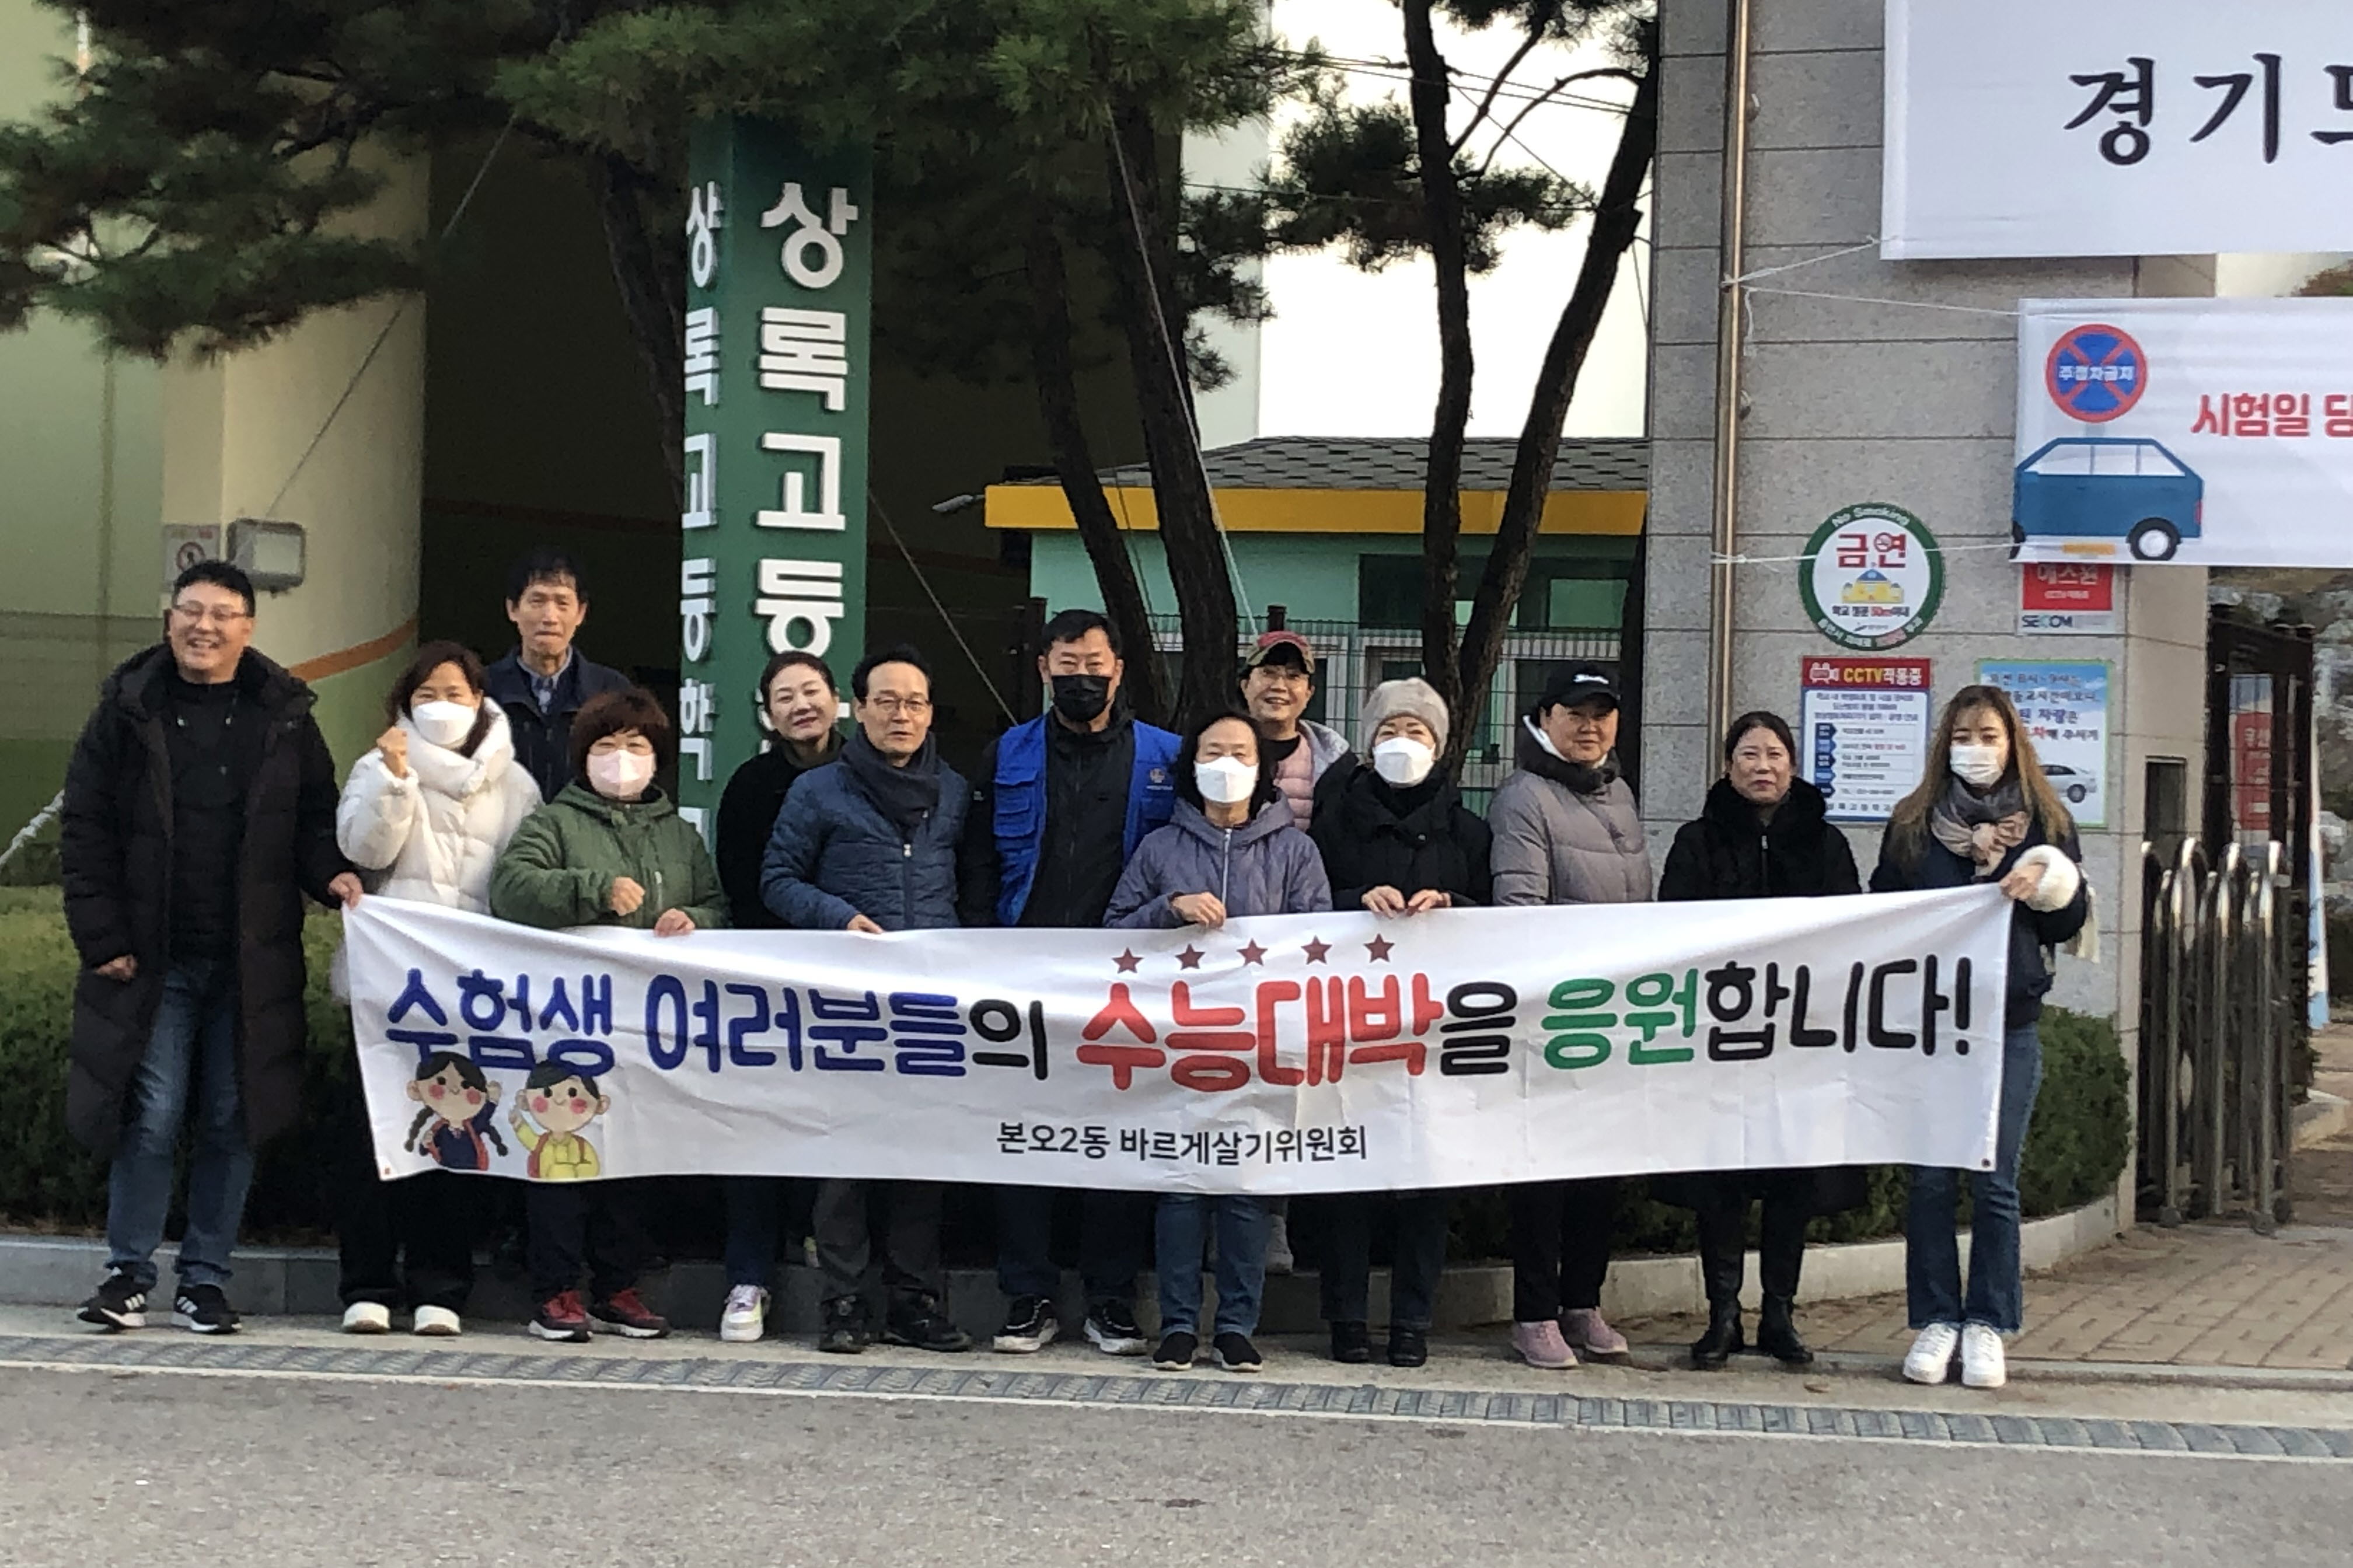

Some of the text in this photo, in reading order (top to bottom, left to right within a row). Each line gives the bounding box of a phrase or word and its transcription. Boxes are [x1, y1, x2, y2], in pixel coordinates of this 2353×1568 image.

[2190, 393, 2311, 437] 시험일
[756, 181, 859, 759] 상록고등
[1836, 532, 1907, 568] 금연
[2022, 614, 2073, 628] SECOM
[386, 954, 1972, 1092] 수험생 여러분들의 수능대박을 응원합니다!
[996, 1122, 1367, 1165] 본오2동 바르게살기위원회
